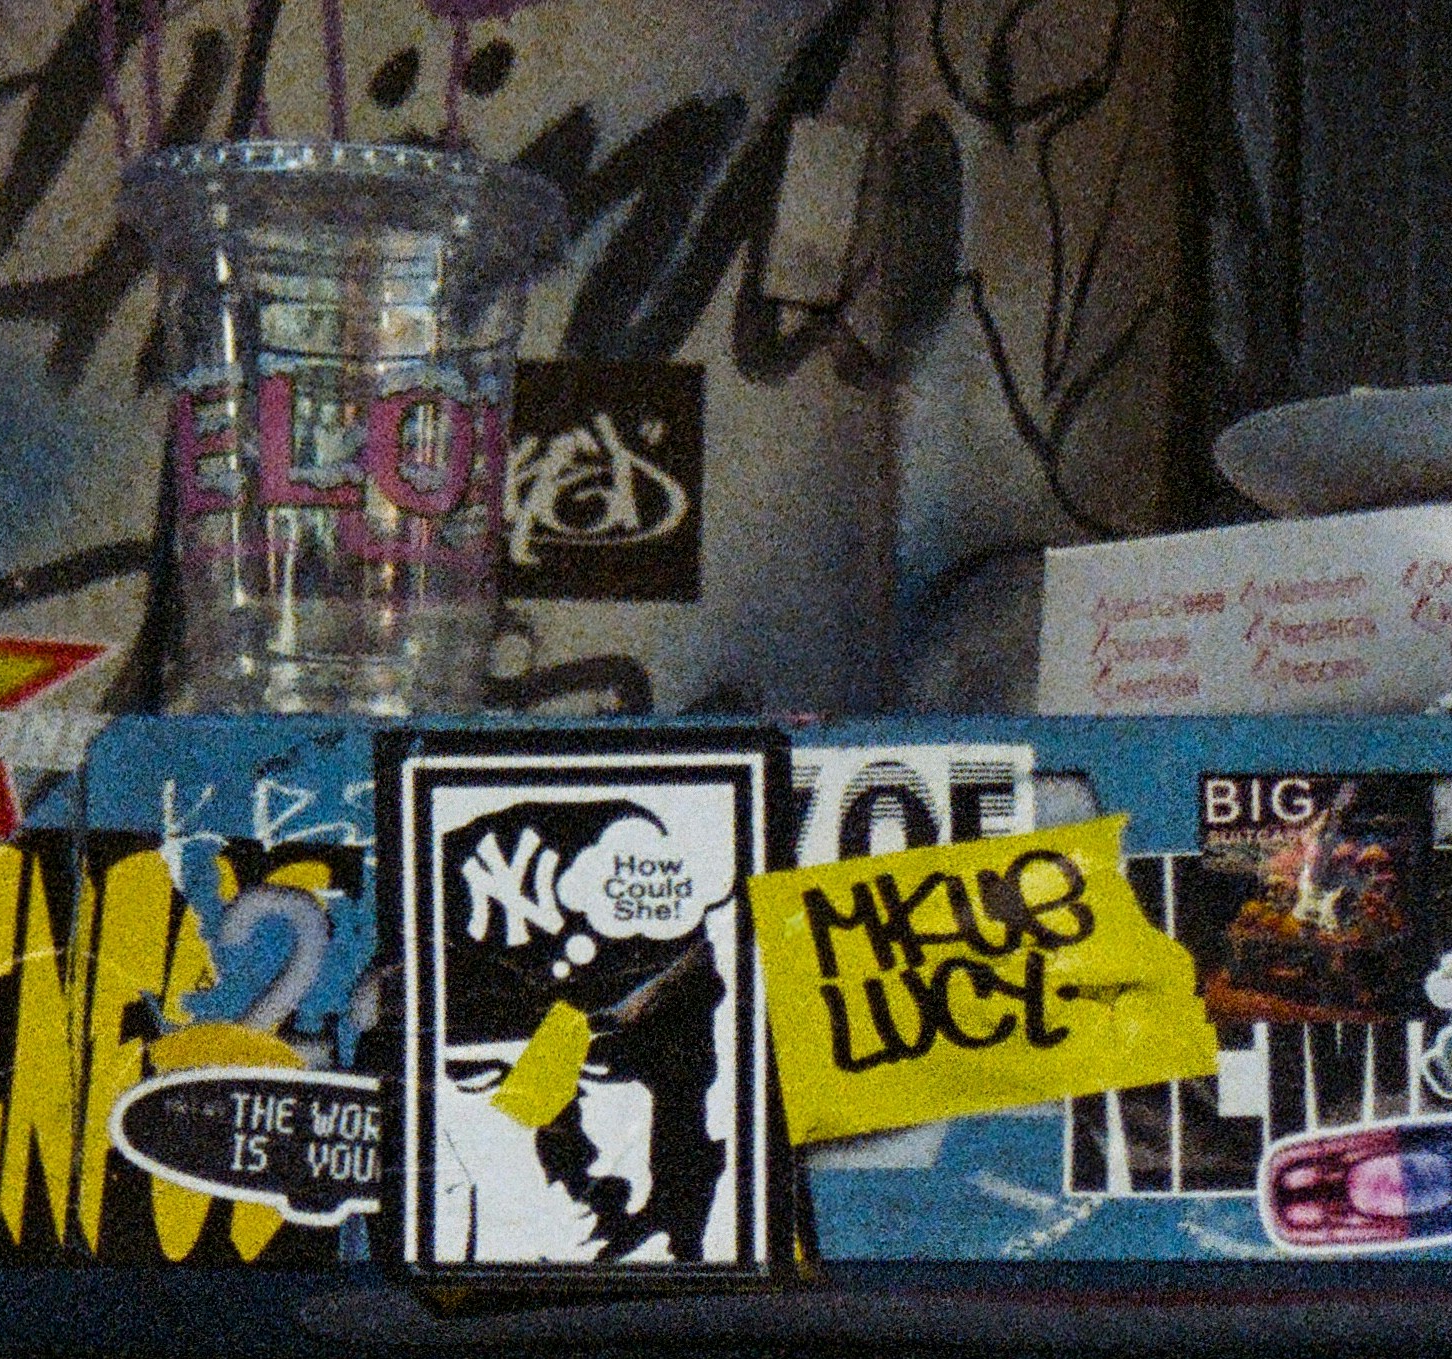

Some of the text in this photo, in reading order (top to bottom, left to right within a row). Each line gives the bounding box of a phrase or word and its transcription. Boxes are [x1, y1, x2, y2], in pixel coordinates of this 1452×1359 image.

[1202, 774, 1318, 826] BIG
[611, 855, 685, 878] How
[603, 877, 694, 902] Could
[611, 901, 684, 922] She!
[231, 1091, 293, 1132] THE
[230, 1133, 269, 1173] IS
